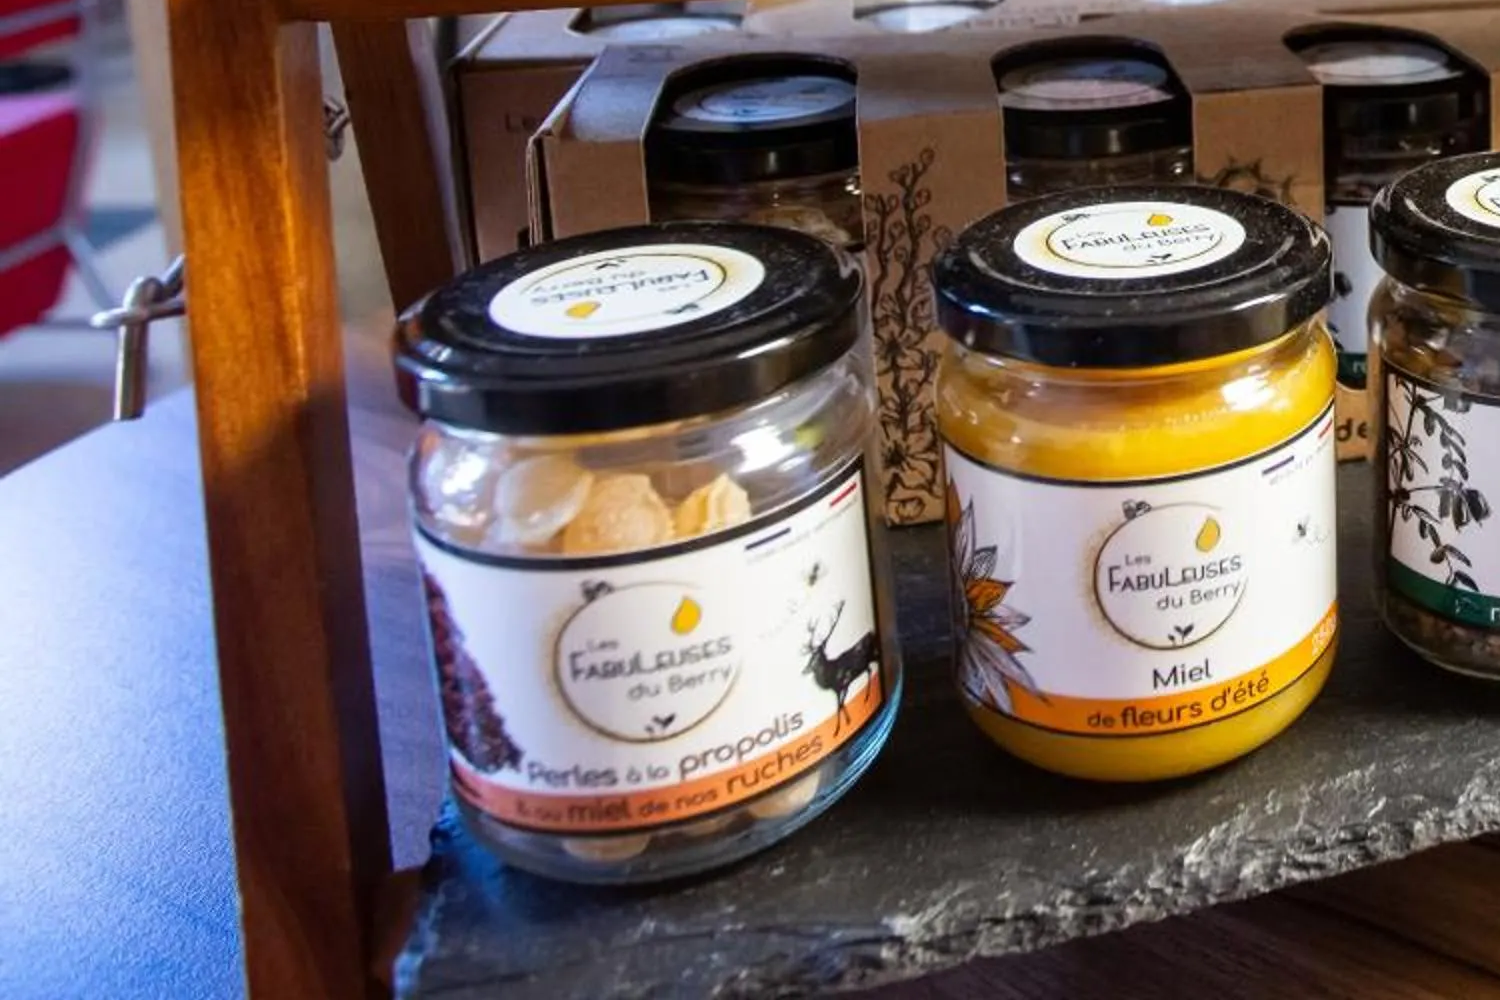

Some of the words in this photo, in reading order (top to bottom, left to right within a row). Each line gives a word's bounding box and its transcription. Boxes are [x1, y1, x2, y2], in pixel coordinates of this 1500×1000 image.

[1124, 554, 1151, 567] Les
[1156, 592, 1183, 612] du
[1189, 580, 1241, 606] Berry
[627, 681, 660, 702] du
[669, 663, 733, 697] Berry
[1152, 659, 1213, 691] Miel
[1087, 711, 1114, 729] de
[1119, 701, 1203, 730] fleurs
[1211, 670, 1270, 714] d'été
[527, 761, 618, 787] Perles
[649, 764, 670, 780] la
[679, 708, 804, 780] propolis
[568, 796, 631, 822] miel
[639, 800, 669, 817] de
[675, 789, 718, 809] nos
[726, 734, 824, 792] ruches
